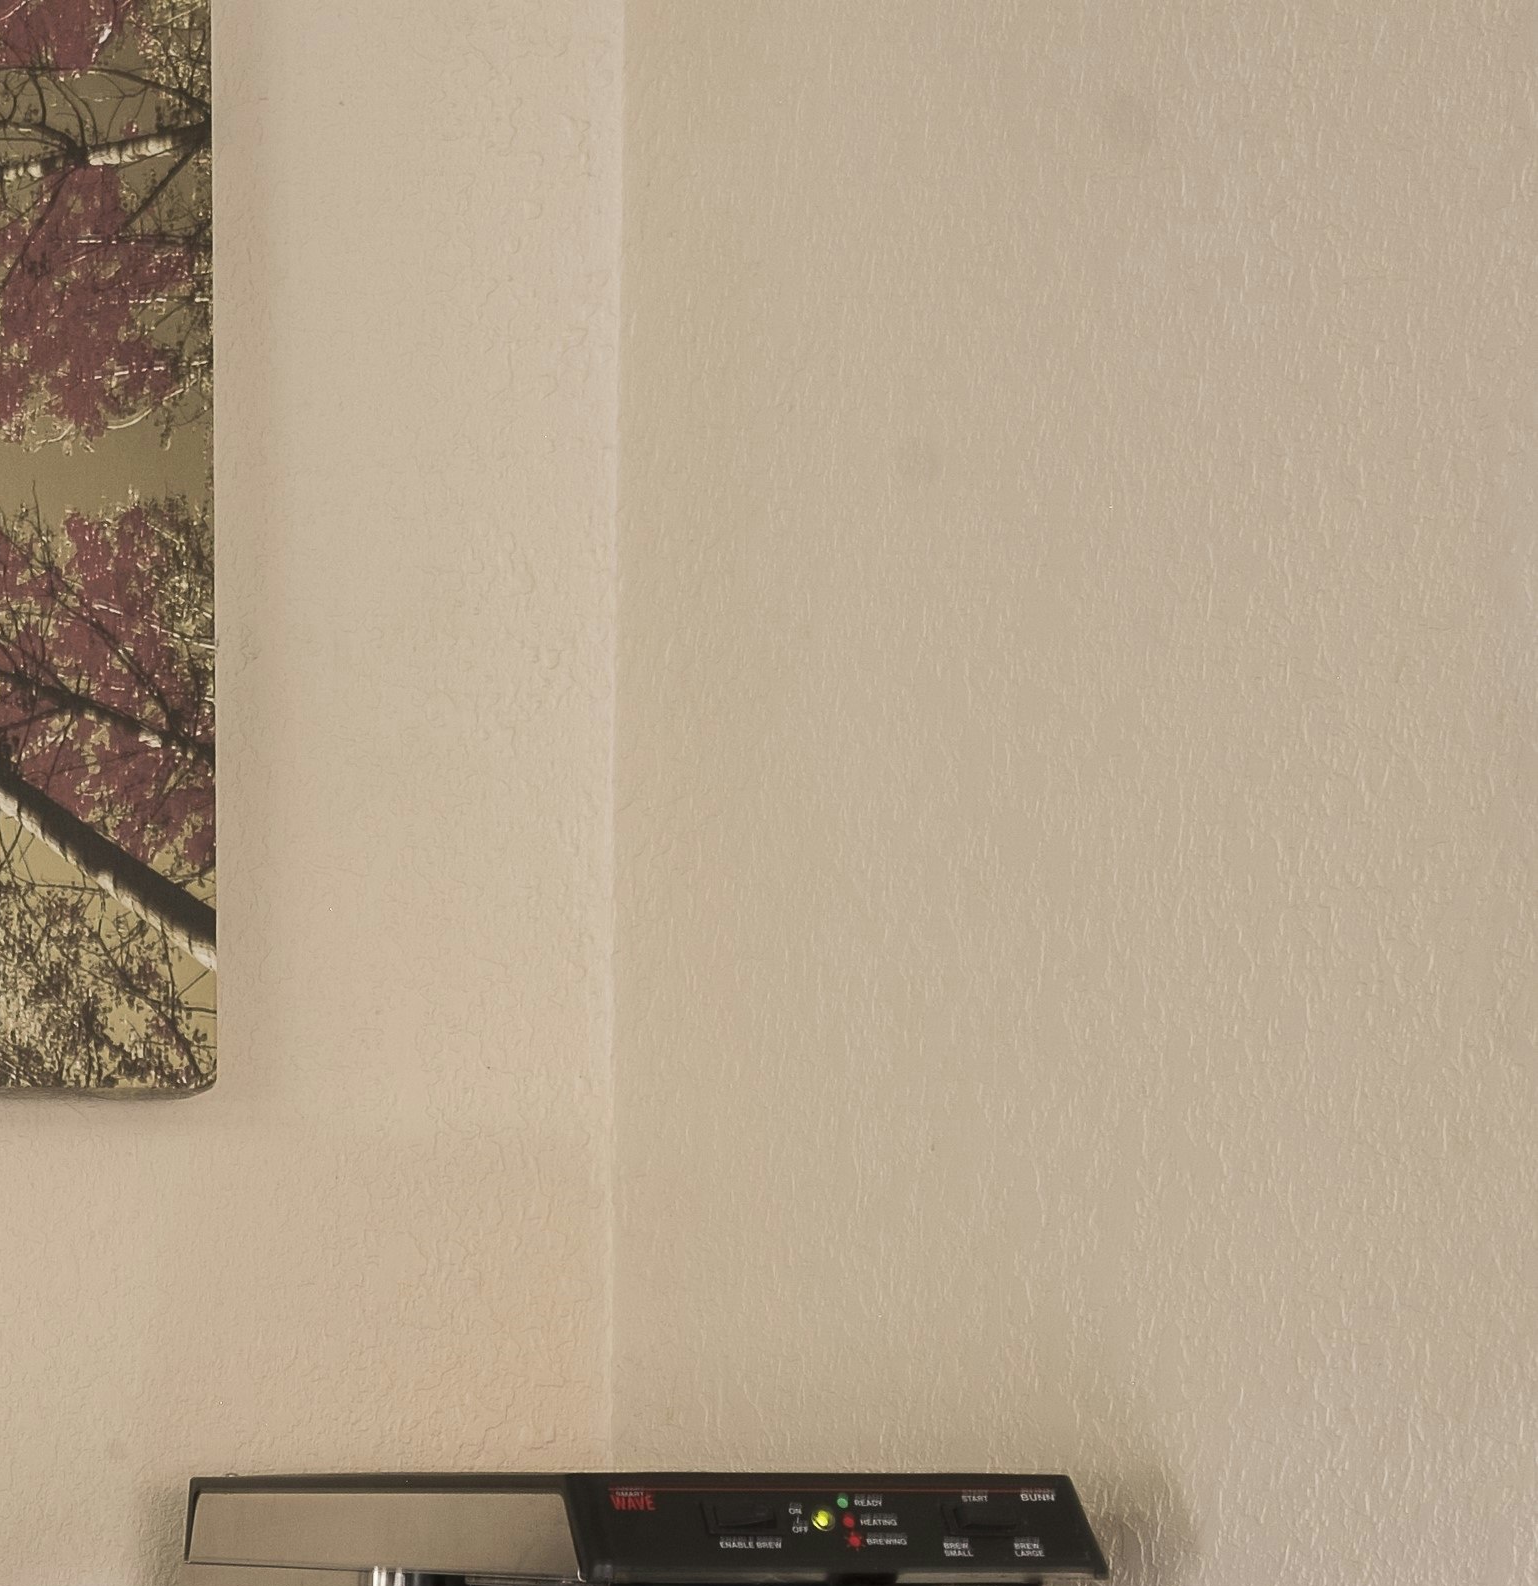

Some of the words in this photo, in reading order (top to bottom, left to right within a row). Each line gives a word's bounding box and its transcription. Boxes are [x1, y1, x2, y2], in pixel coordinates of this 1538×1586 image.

[1020, 1493, 1055, 1502] BUNN
[610, 1495, 656, 1511] WAVE
[854, 1499, 883, 1507] READY
[860, 1518, 897, 1526] HEATING
[792, 1526, 808, 1534] OFF
[719, 1541, 755, 1549] ENABLE
[756, 1541, 782, 1549] BREW
[866, 1538, 907, 1546] BREWING
